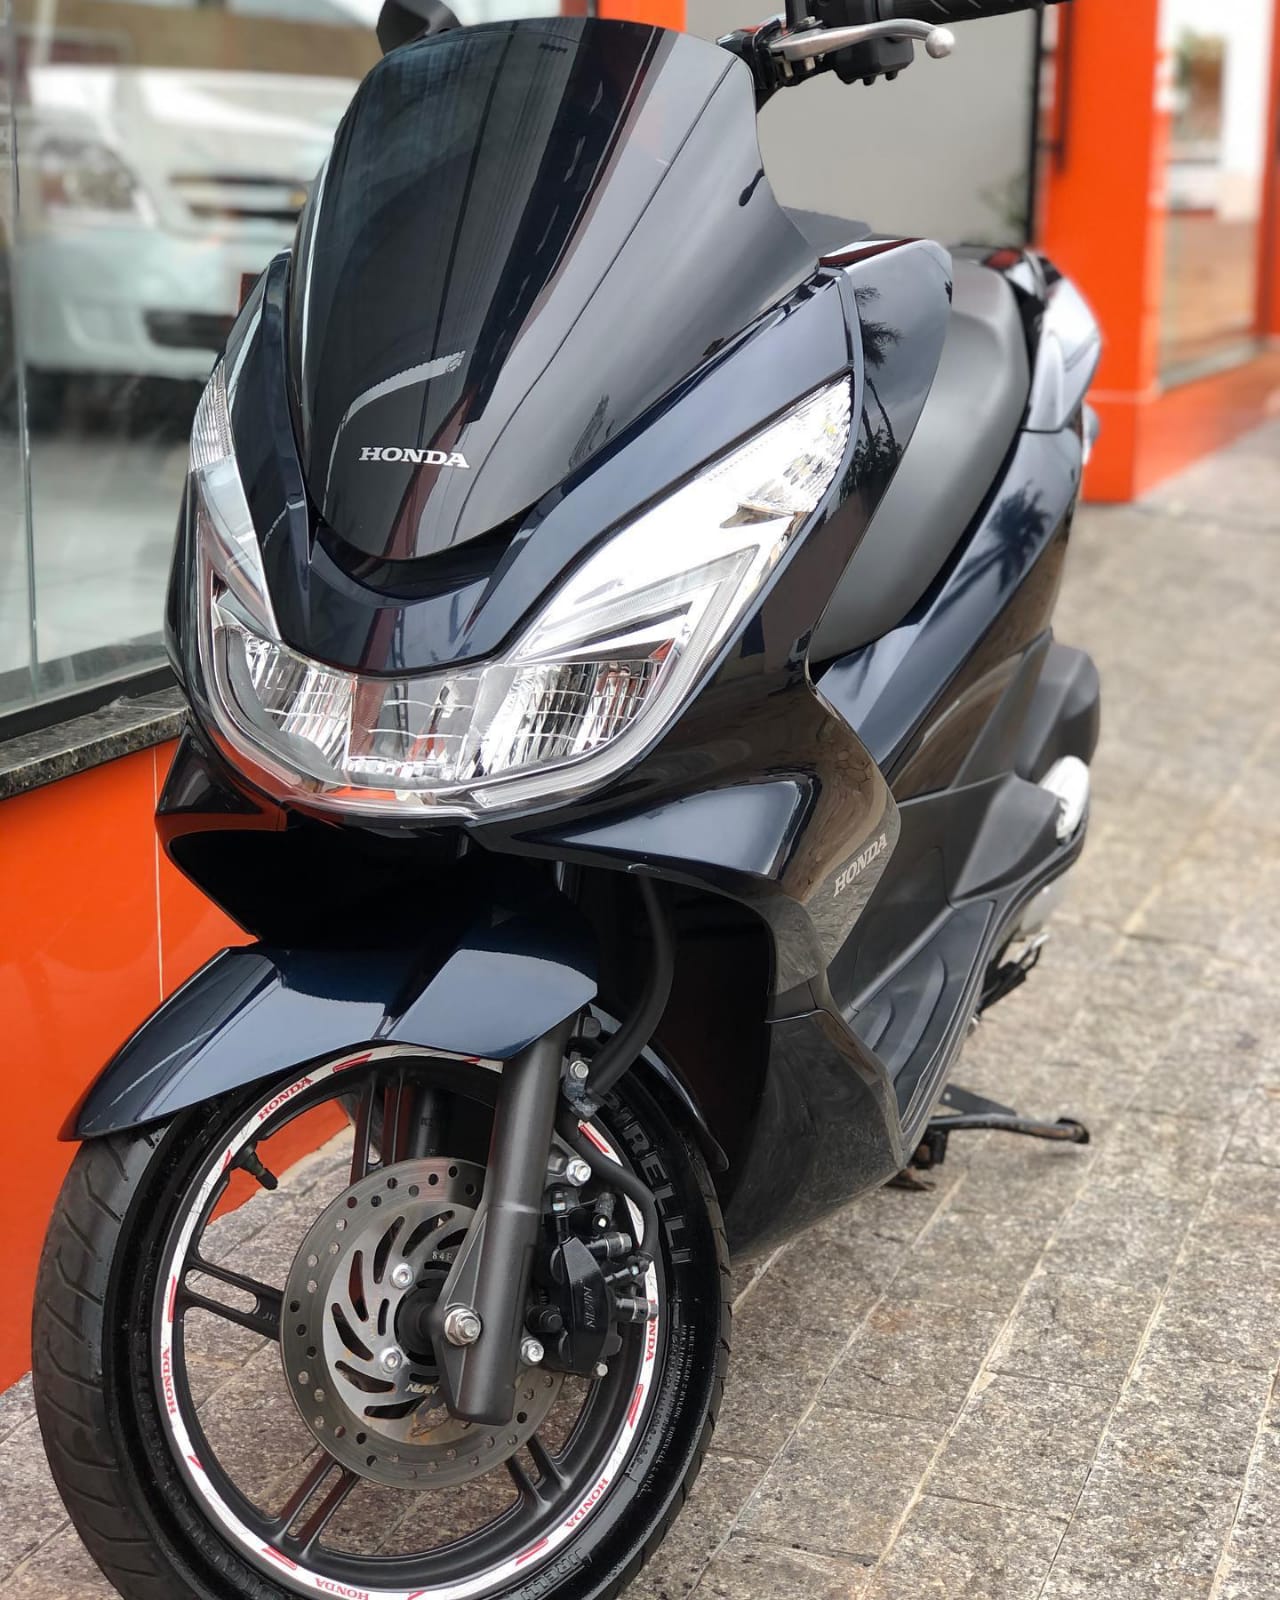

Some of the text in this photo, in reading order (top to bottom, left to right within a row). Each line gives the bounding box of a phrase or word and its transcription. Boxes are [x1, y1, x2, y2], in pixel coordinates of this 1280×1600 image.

[358, 446, 470, 469] HONDA
[833, 833, 888, 897] HONDA
[257, 1076, 314, 1121] HONDA
[161, 1346, 177, 1415] HONDA
[564, 1477, 609, 1529] HONDA
[315, 1577, 369, 1600] HONDA
